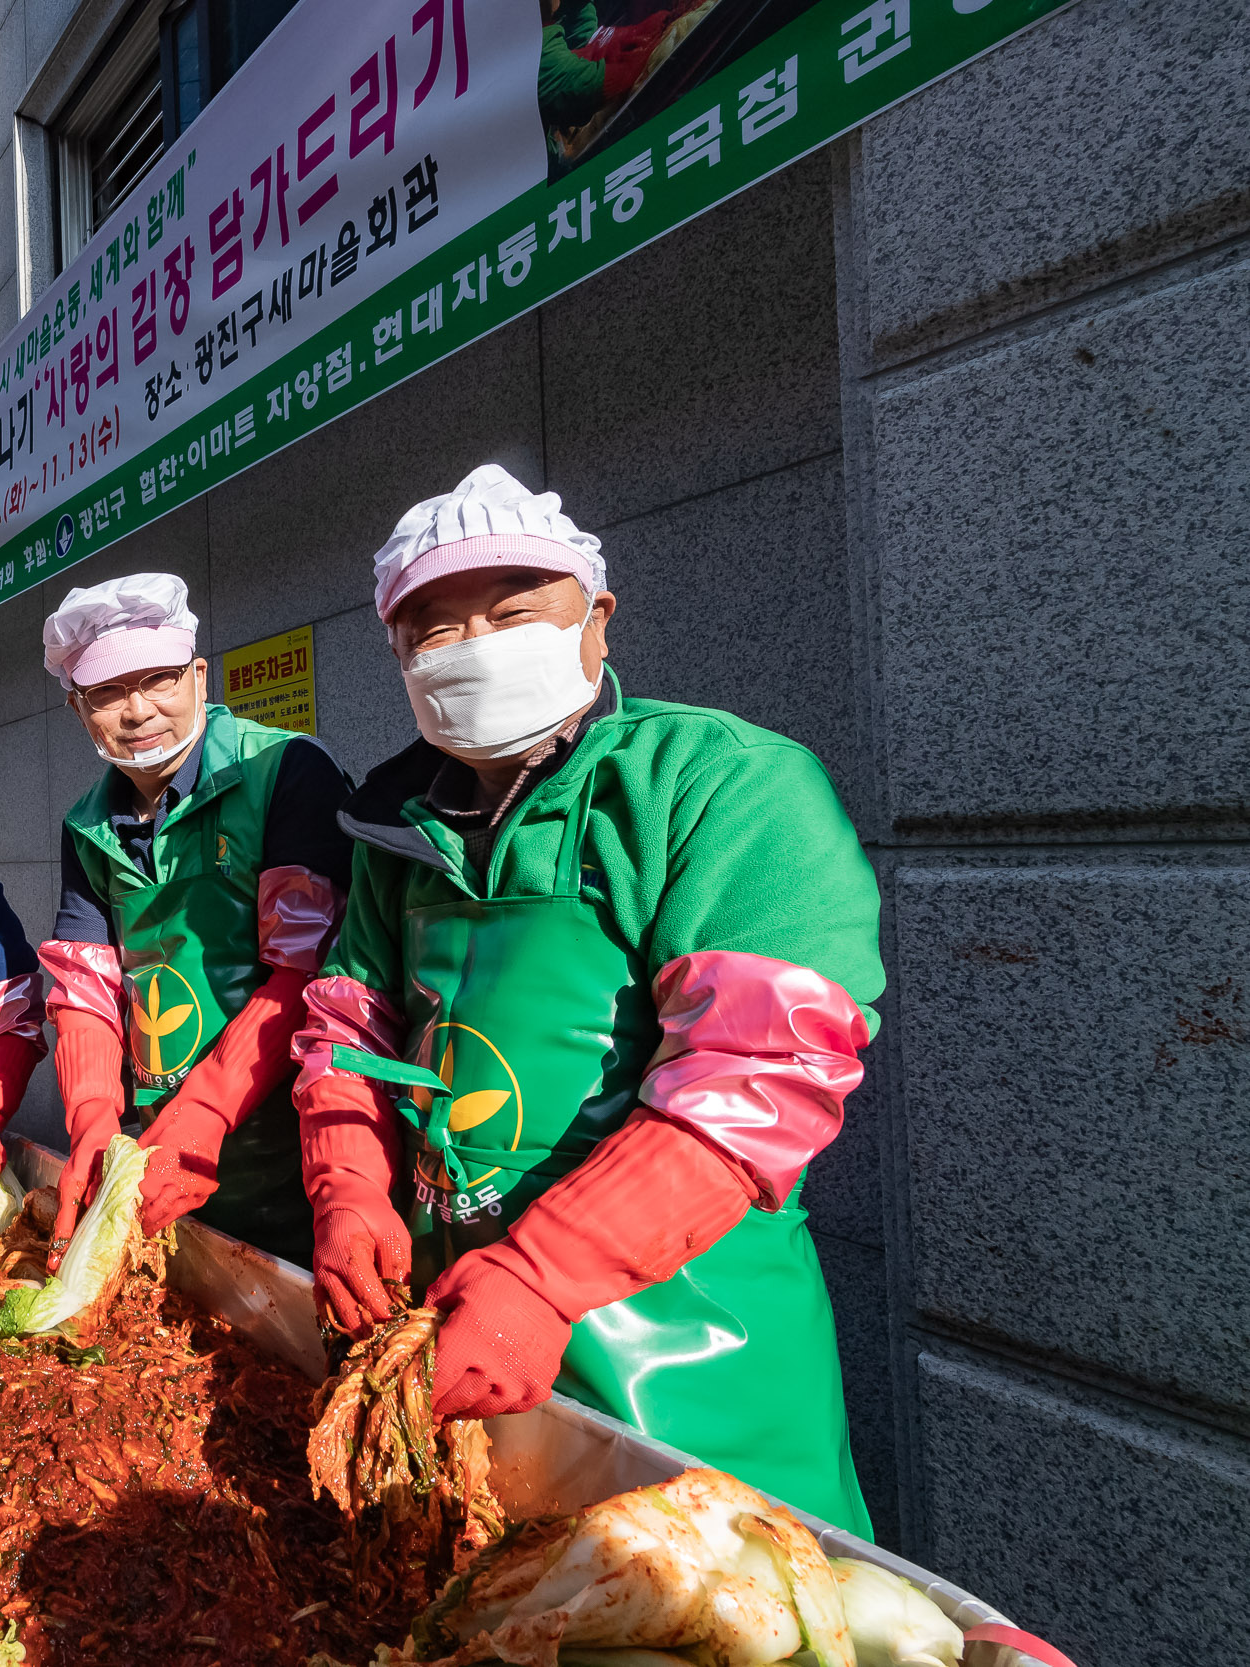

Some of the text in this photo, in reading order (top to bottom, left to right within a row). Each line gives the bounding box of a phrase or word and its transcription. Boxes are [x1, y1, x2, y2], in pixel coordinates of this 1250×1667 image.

[89, 215, 141, 303] 세계와
[131, 235, 196, 367] 김장
[23, 537, 52, 573] 후원:
[78, 486, 126, 540] 광진구
[229, 646, 308, 692] 불법주차금지
